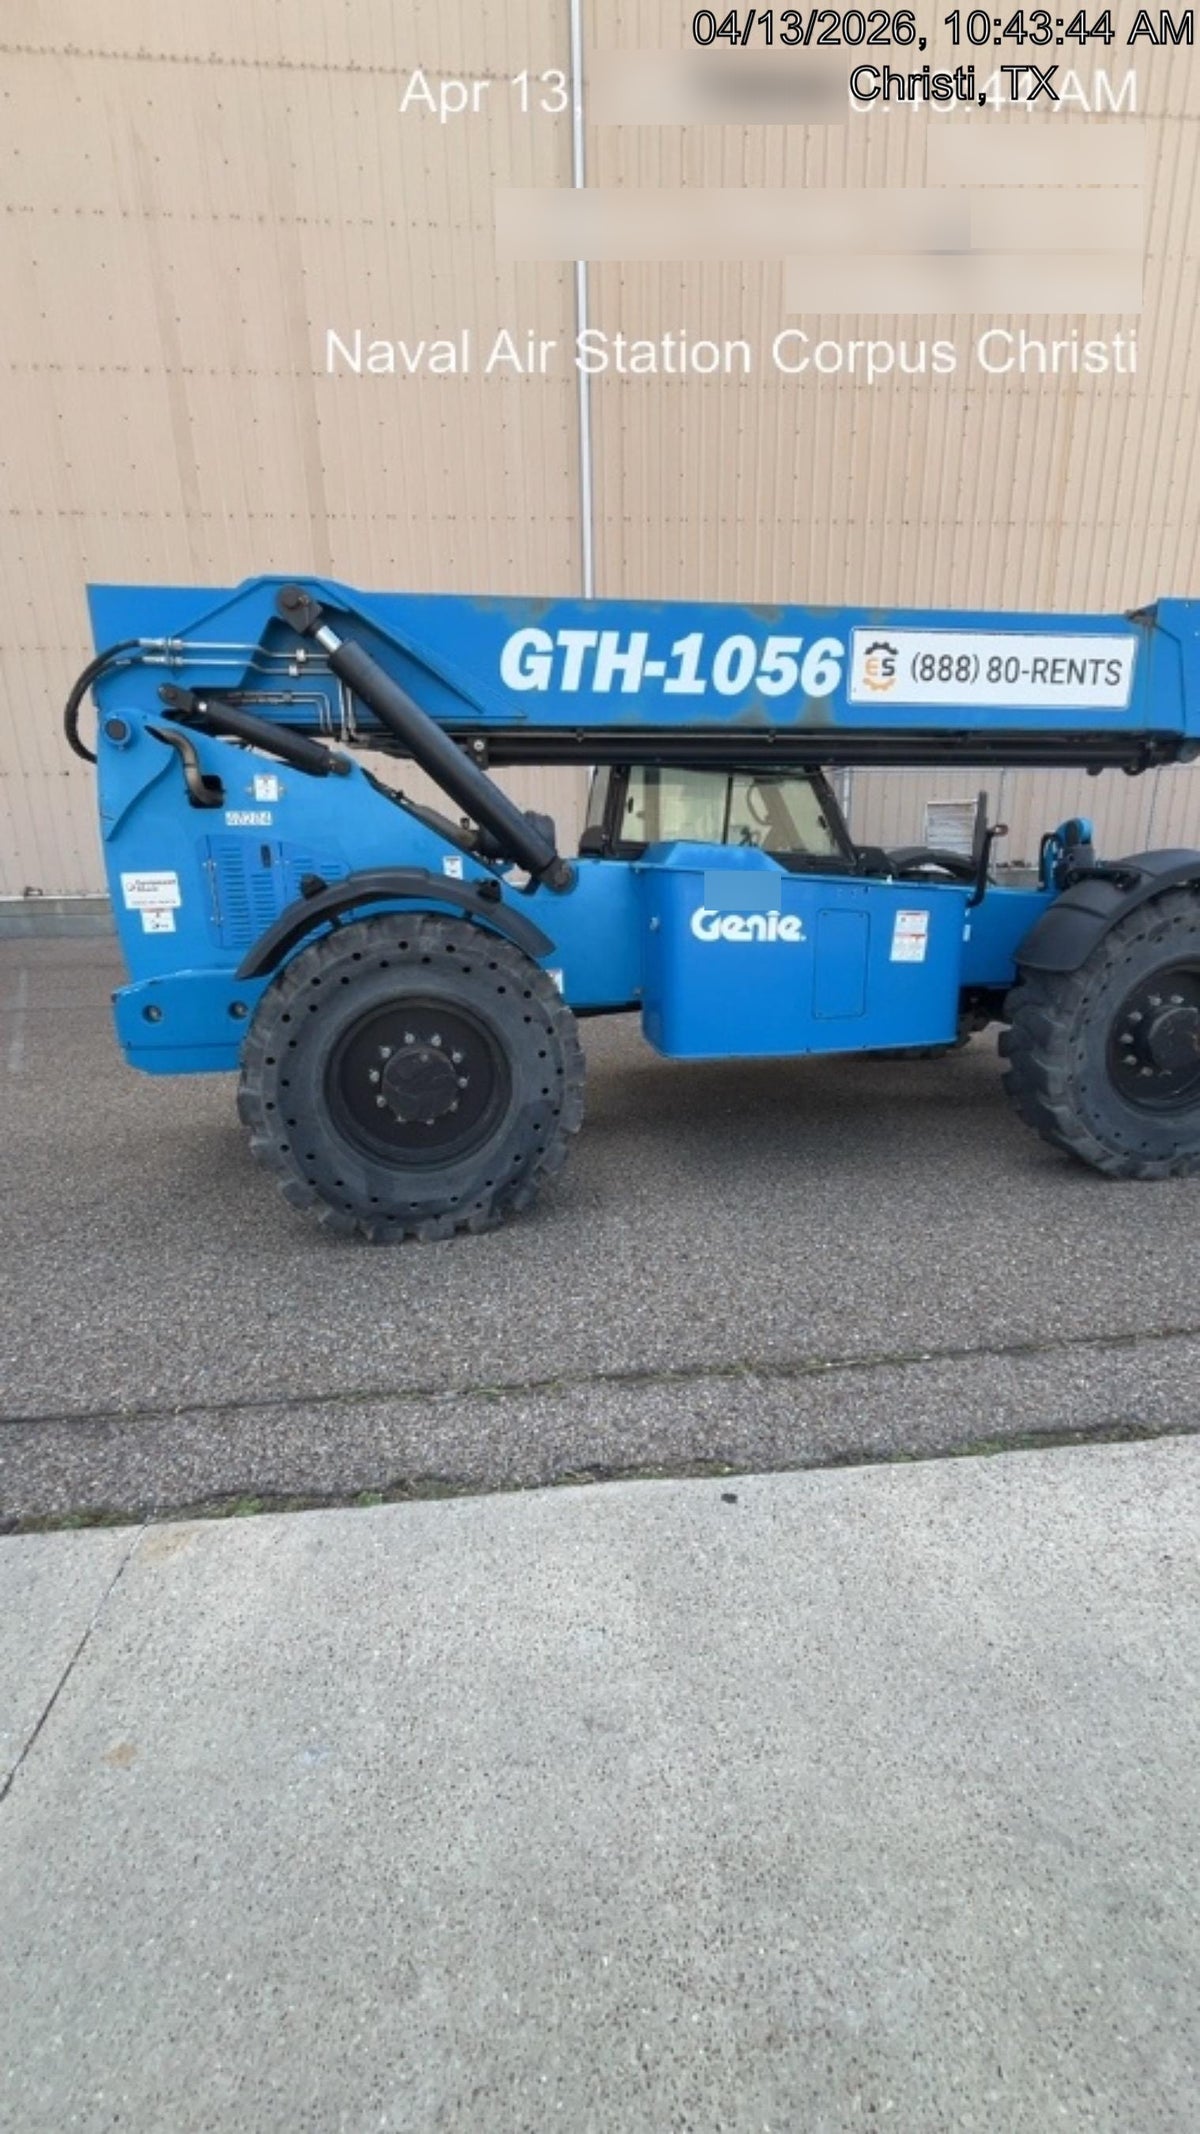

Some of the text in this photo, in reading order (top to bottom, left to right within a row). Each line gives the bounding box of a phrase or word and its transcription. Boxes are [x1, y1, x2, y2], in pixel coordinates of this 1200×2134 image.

[500, 627, 845, 697] GTH-1056
[910, 651, 1123, 686] (888) 80-RENTS
[690, 905, 804, 943] Genie
